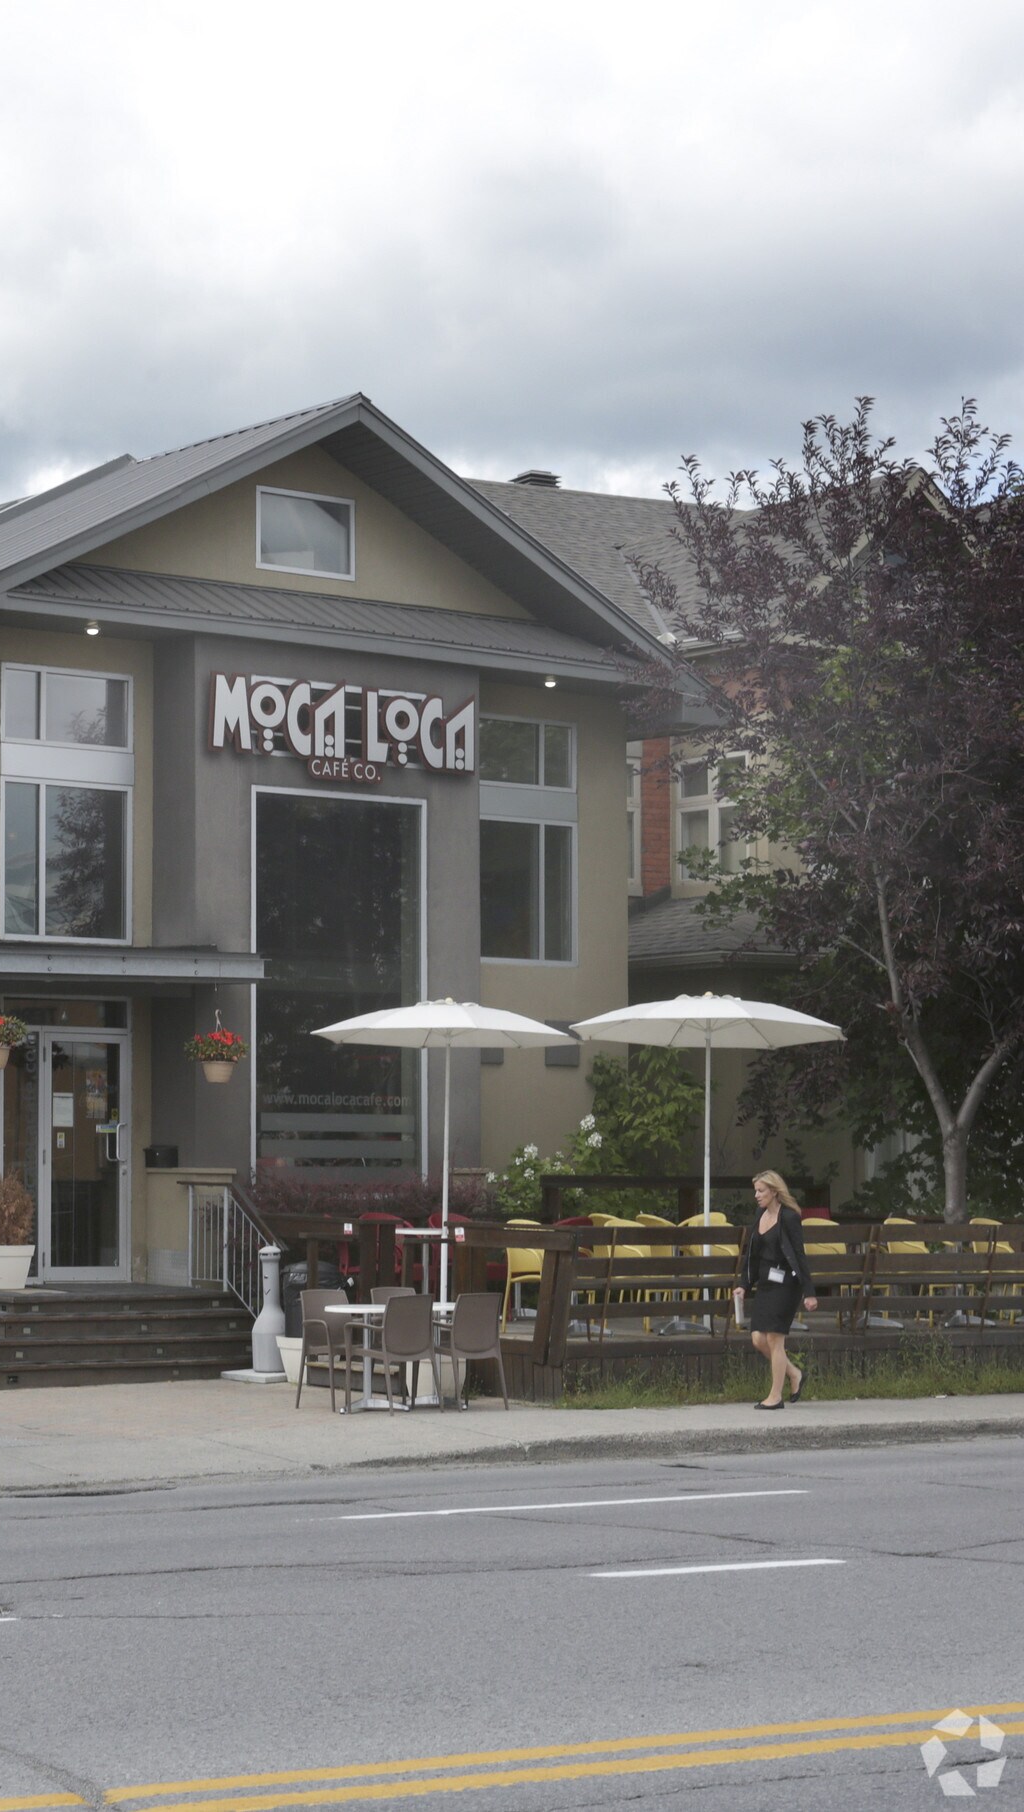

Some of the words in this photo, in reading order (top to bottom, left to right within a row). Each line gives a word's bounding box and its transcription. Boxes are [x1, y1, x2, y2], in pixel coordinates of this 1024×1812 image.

[210, 672, 346, 759] MOCA
[362, 687, 475, 771] LOCA
[311, 758, 349, 778] CAFÉ
[353, 763, 382, 781] CO.
